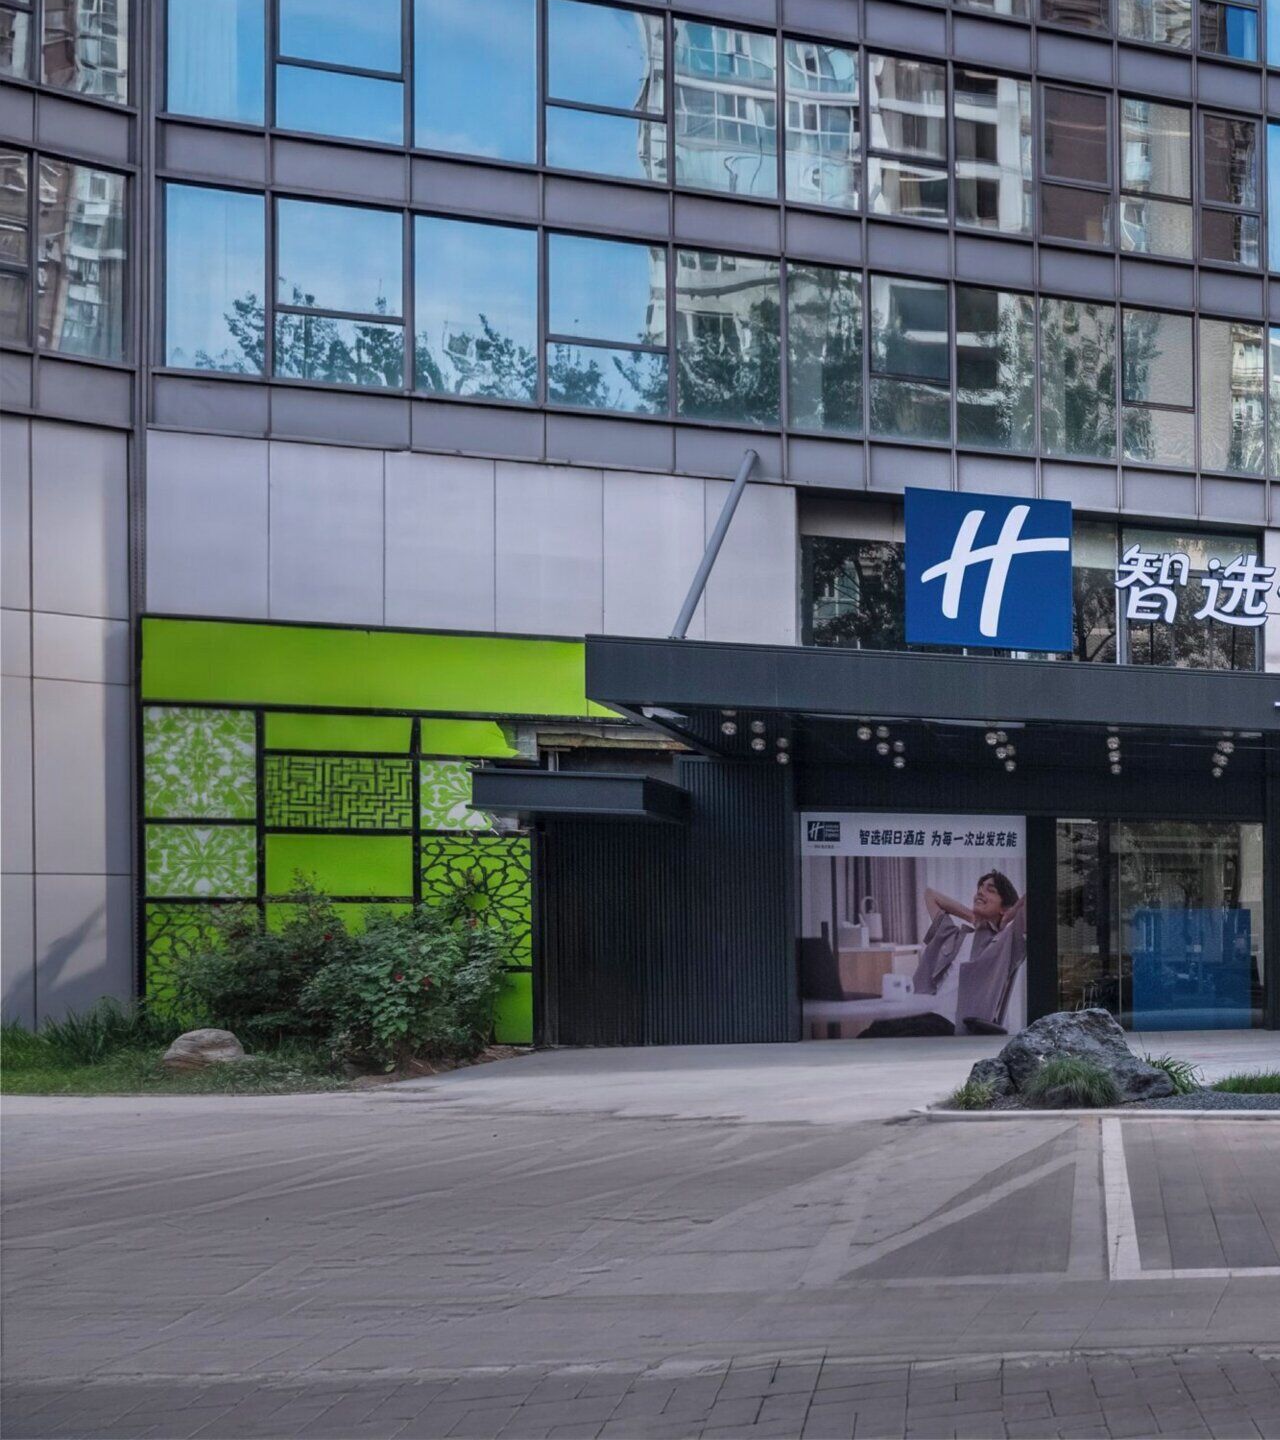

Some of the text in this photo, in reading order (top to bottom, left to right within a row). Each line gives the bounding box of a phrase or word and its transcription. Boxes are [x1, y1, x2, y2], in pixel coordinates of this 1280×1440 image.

[859, 828, 926, 847] 智选假日酒店
[930, 830, 1018, 848] 为每一次出发充能
